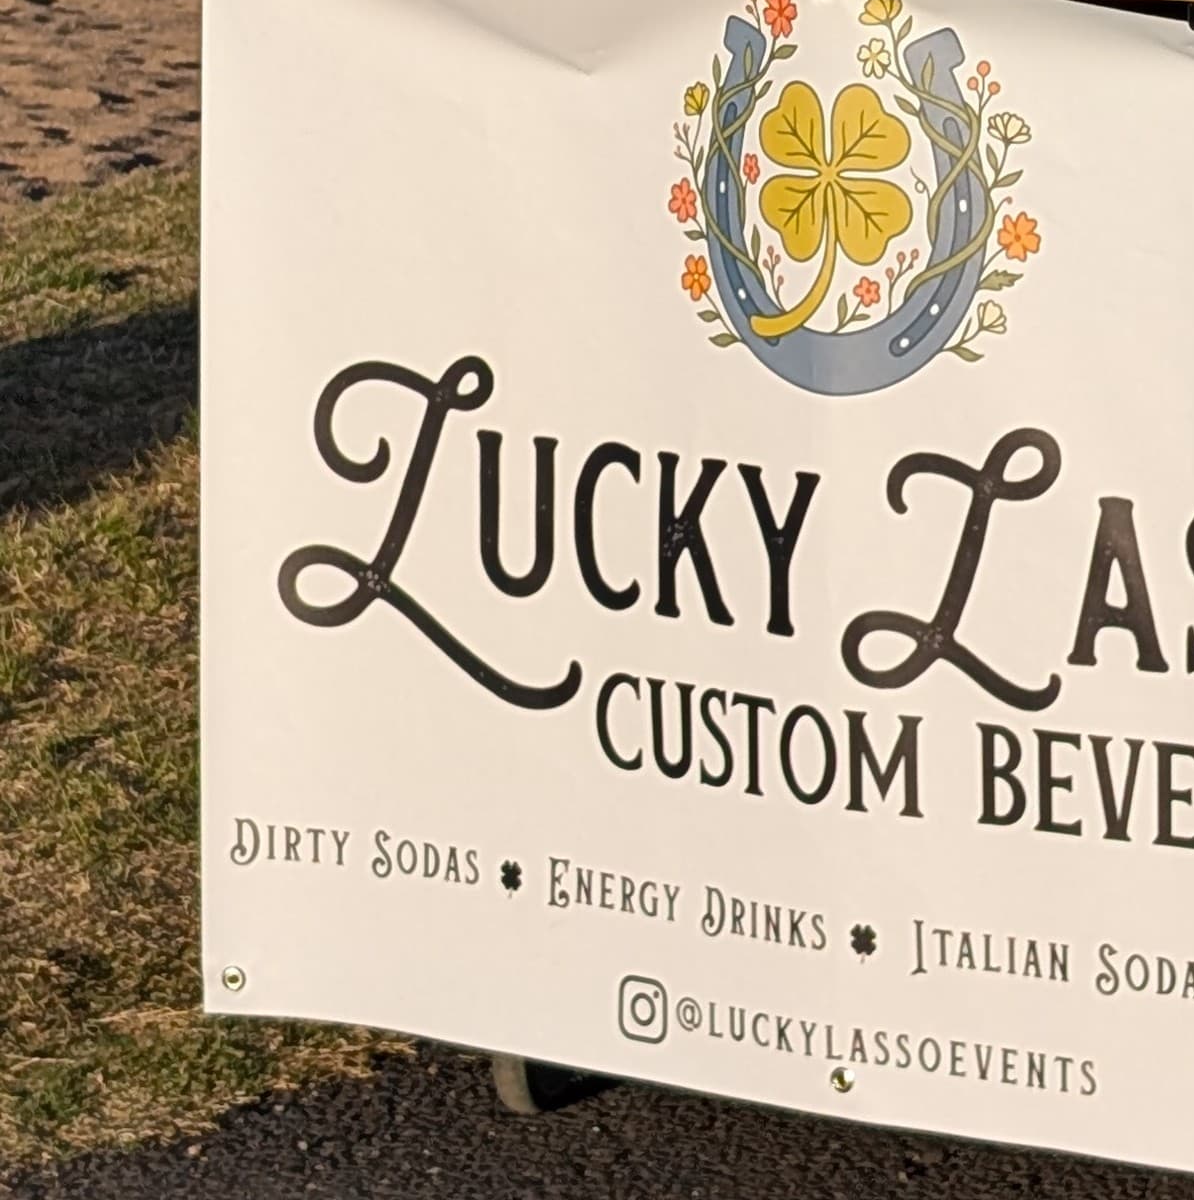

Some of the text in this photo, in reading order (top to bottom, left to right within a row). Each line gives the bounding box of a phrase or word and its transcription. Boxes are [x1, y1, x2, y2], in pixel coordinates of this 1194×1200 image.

[278, 356, 820, 710] LUCKY
[596, 673, 924, 818] CUSTOM
[229, 818, 349, 867] DIRTY
[371, 830, 480, 886] SODAS
[548, 857, 680, 922] ENERGY
[701, 886, 826, 951] DRINKS
[911, 919, 1069, 982] ITALIAN
[676, 996, 1097, 1097] @LUCKYLASSOEVENTS
